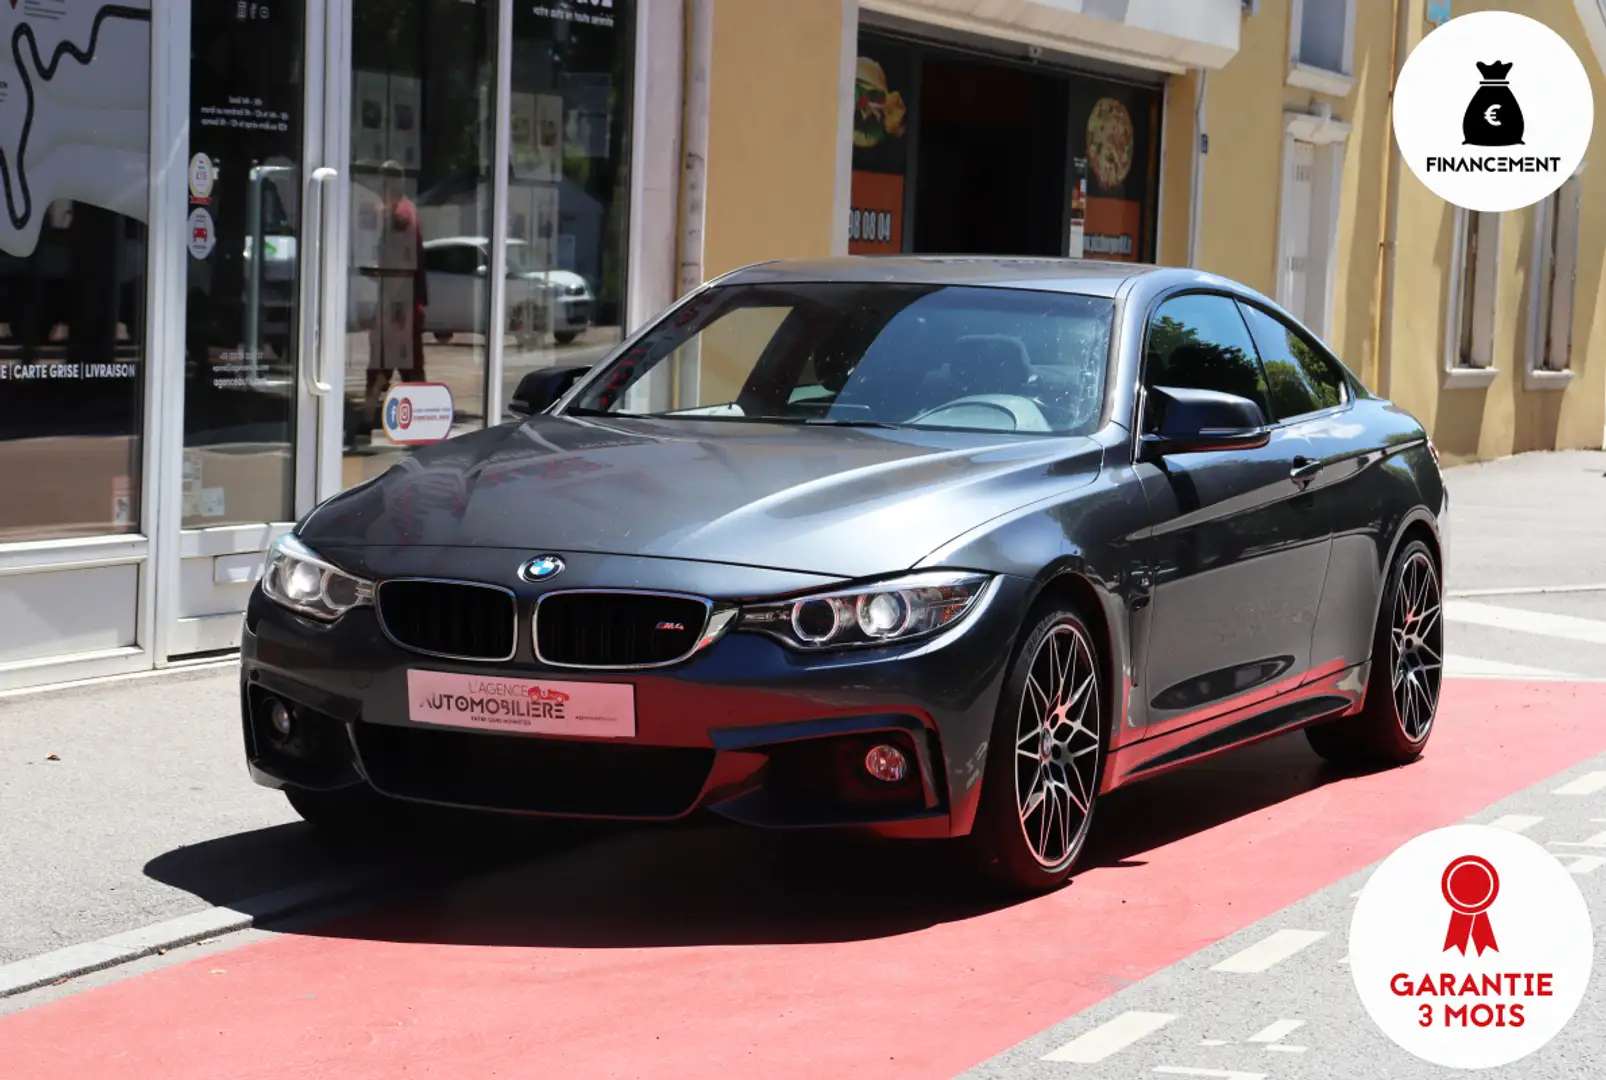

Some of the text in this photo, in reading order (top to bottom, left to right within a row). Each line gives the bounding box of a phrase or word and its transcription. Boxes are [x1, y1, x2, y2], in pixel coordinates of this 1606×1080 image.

[13, 364, 47, 379] CARTE
[49, 363, 79, 379] GRISE
[85, 363, 136, 378] LIVRAISON
[468, 680, 529, 698] L'AGENCE
